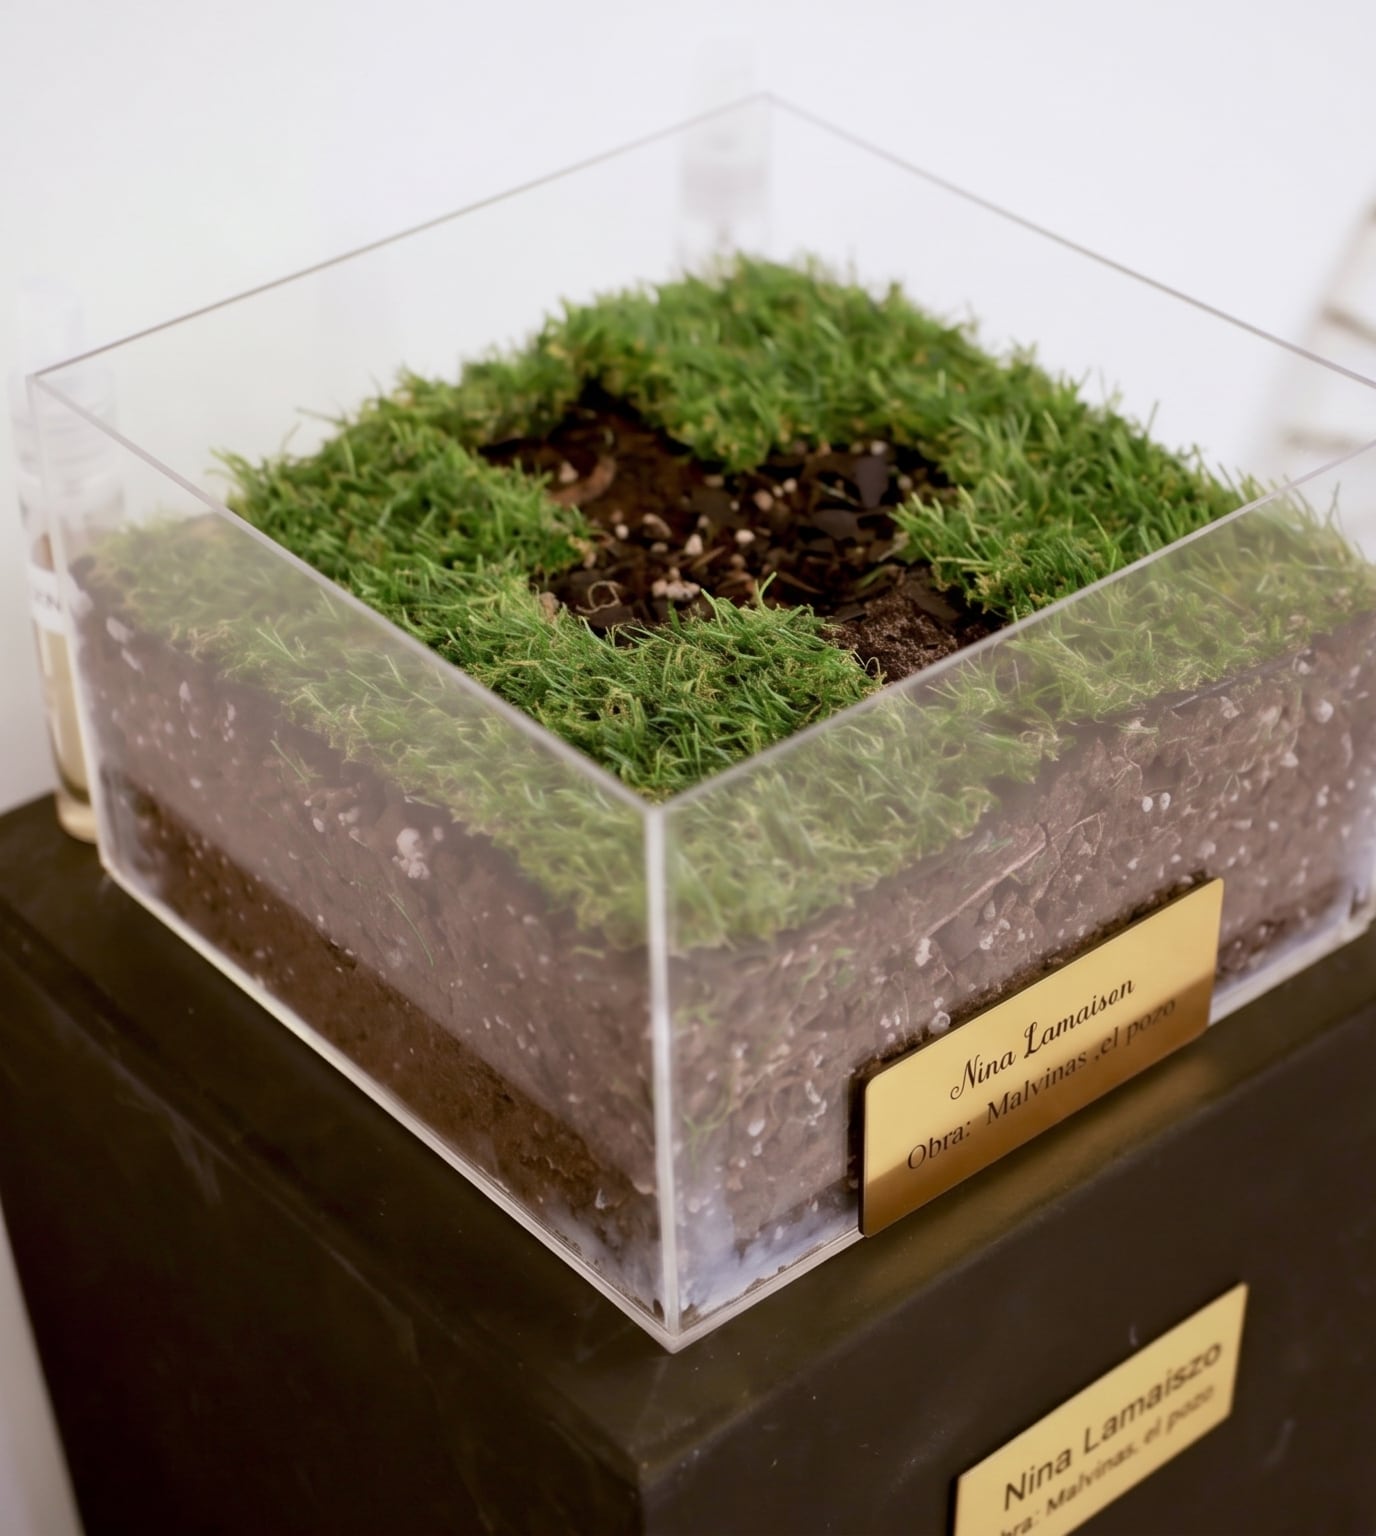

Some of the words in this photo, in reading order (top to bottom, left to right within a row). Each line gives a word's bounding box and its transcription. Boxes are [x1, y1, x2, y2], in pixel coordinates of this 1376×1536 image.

[907, 1121, 971, 1169] Obra:
[986, 1051, 1087, 1125] Malvinas
[1126, 999, 1176, 1046] pozo
[951, 1051, 1016, 1100] Nina
[1024, 980, 1134, 1058] Lamaison
[1004, 1448, 1072, 1511] Nina
